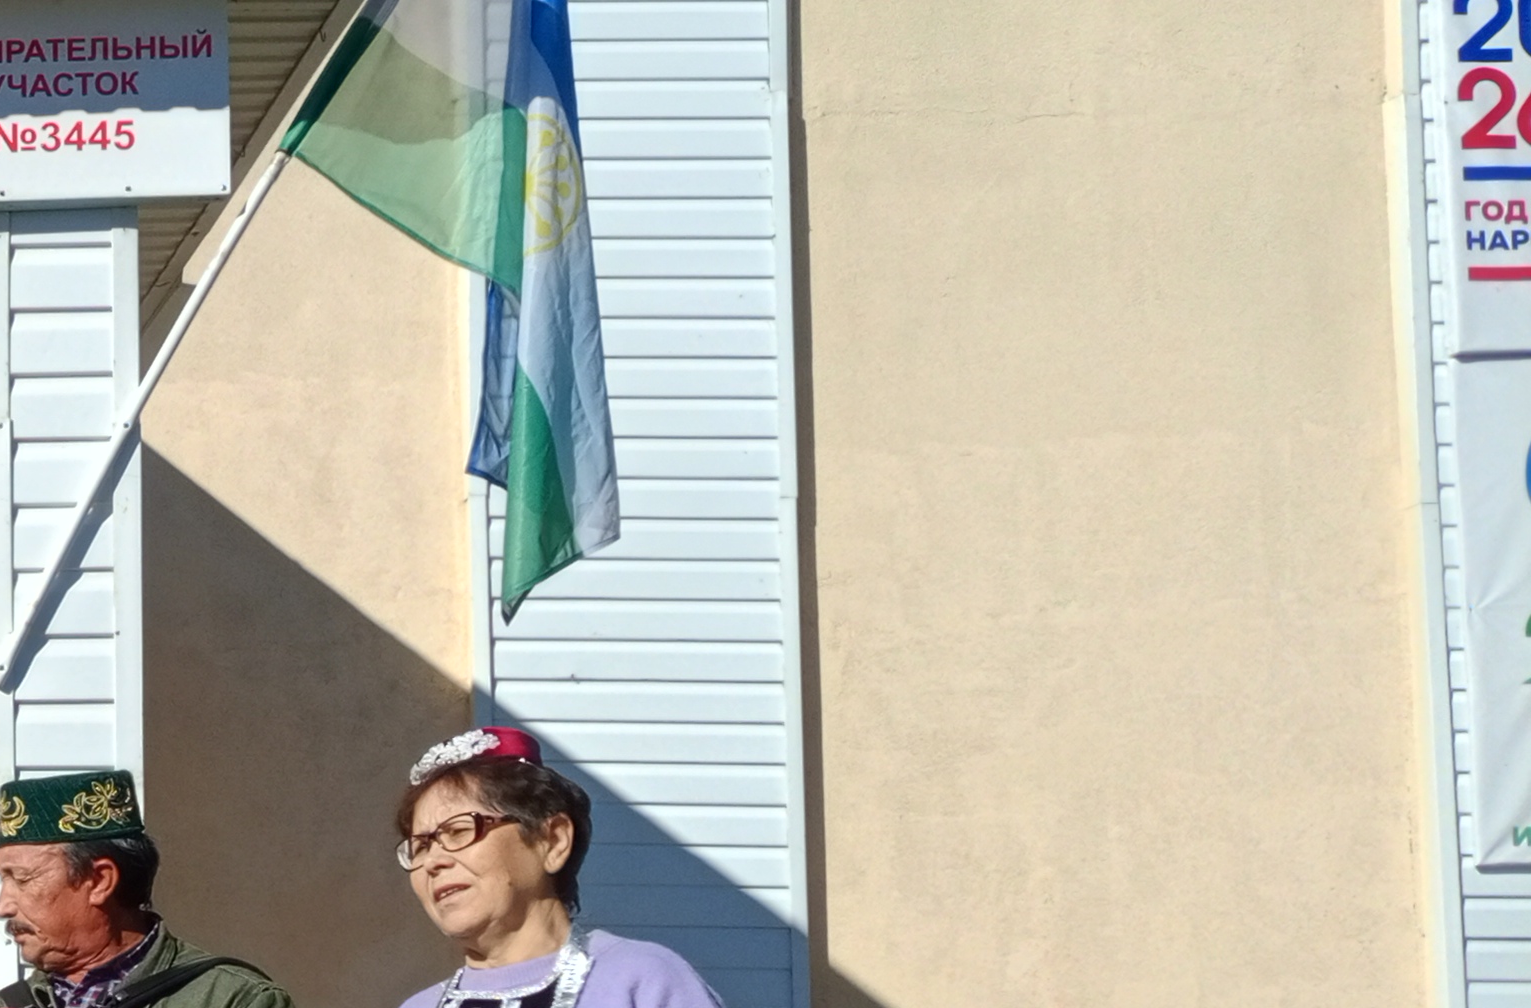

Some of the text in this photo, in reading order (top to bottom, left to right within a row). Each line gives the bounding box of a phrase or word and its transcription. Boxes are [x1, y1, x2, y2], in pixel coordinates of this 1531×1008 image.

[1452, 0, 1531, 63] 2
[1457, 66, 1531, 150] 2
[1465, 200, 1529, 225] ГОД
